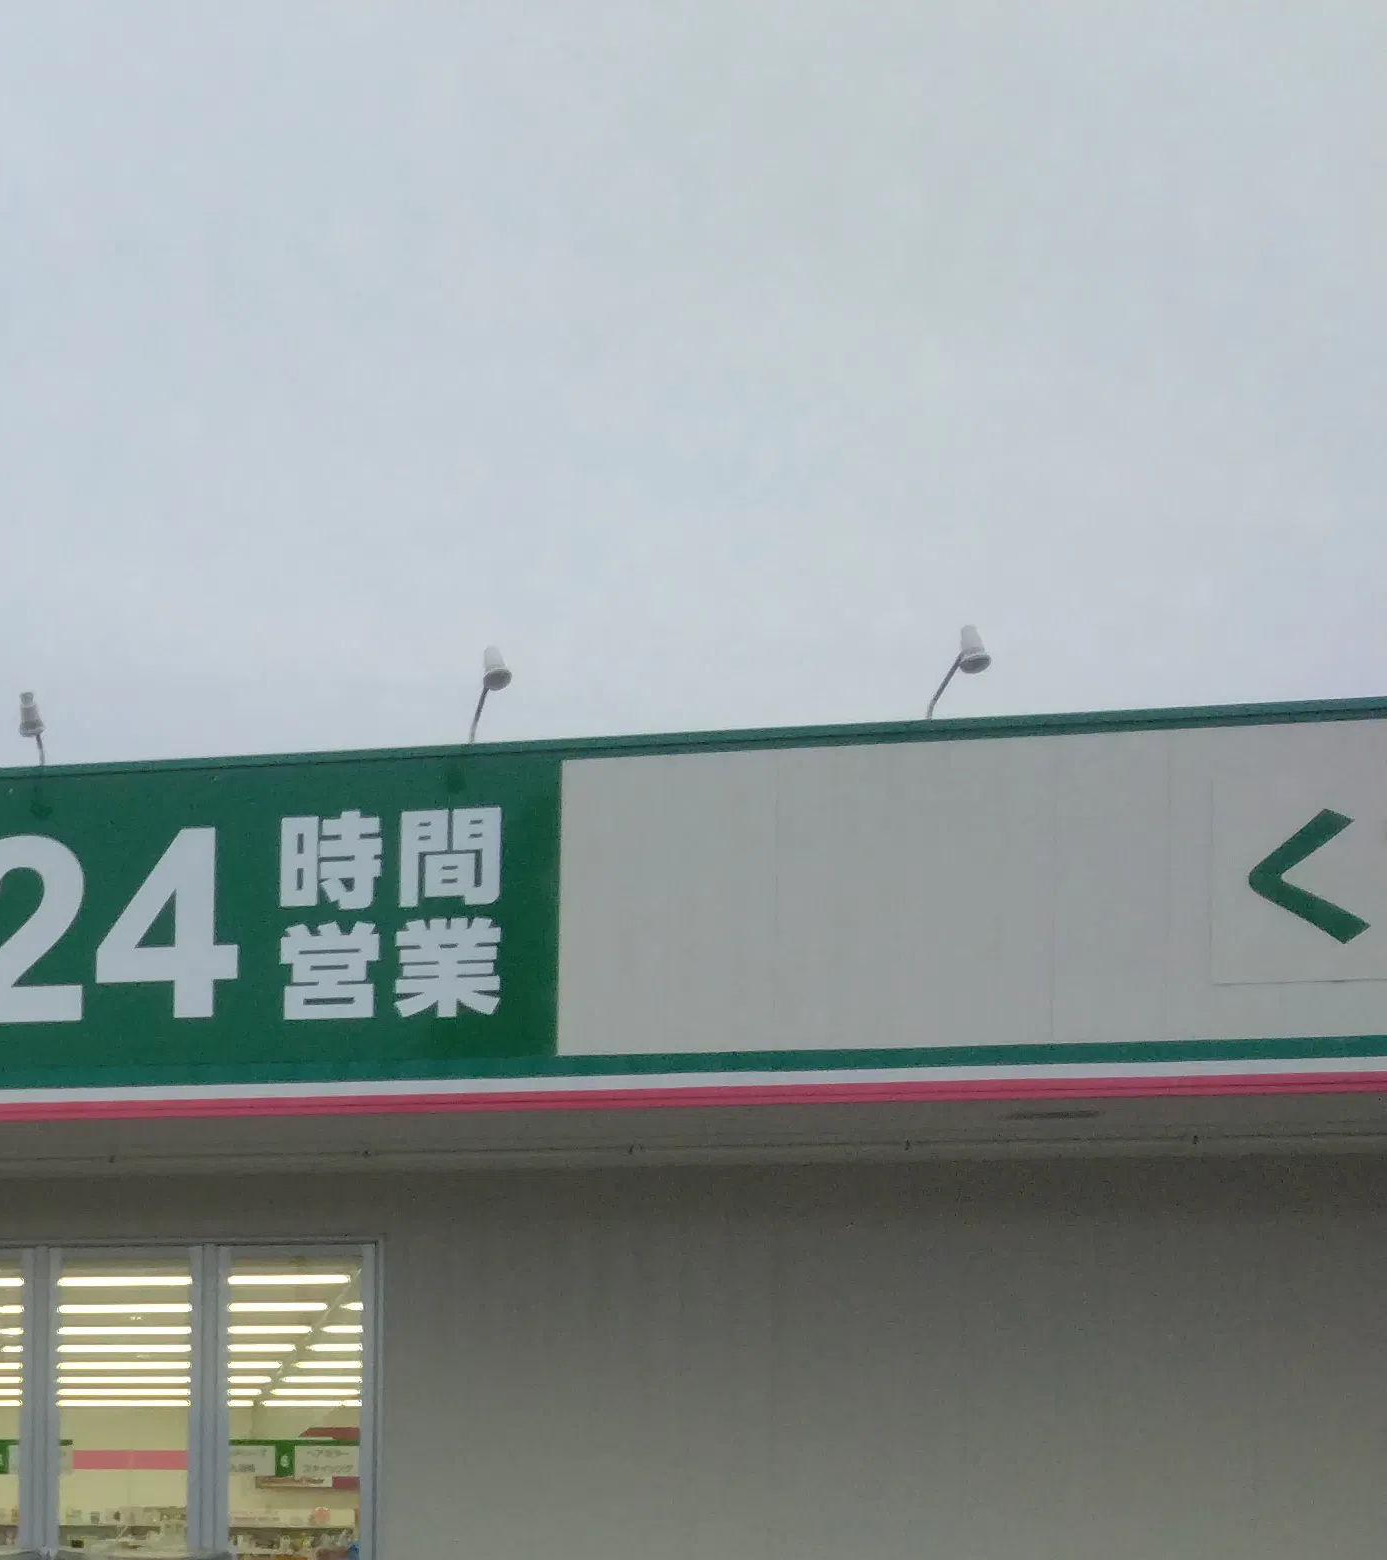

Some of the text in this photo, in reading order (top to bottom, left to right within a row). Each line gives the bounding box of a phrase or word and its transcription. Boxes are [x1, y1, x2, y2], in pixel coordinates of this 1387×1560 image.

[279, 806, 503, 910] 時間
[1248, 808, 1371, 944] く
[279, 917, 502, 1020] 営業
